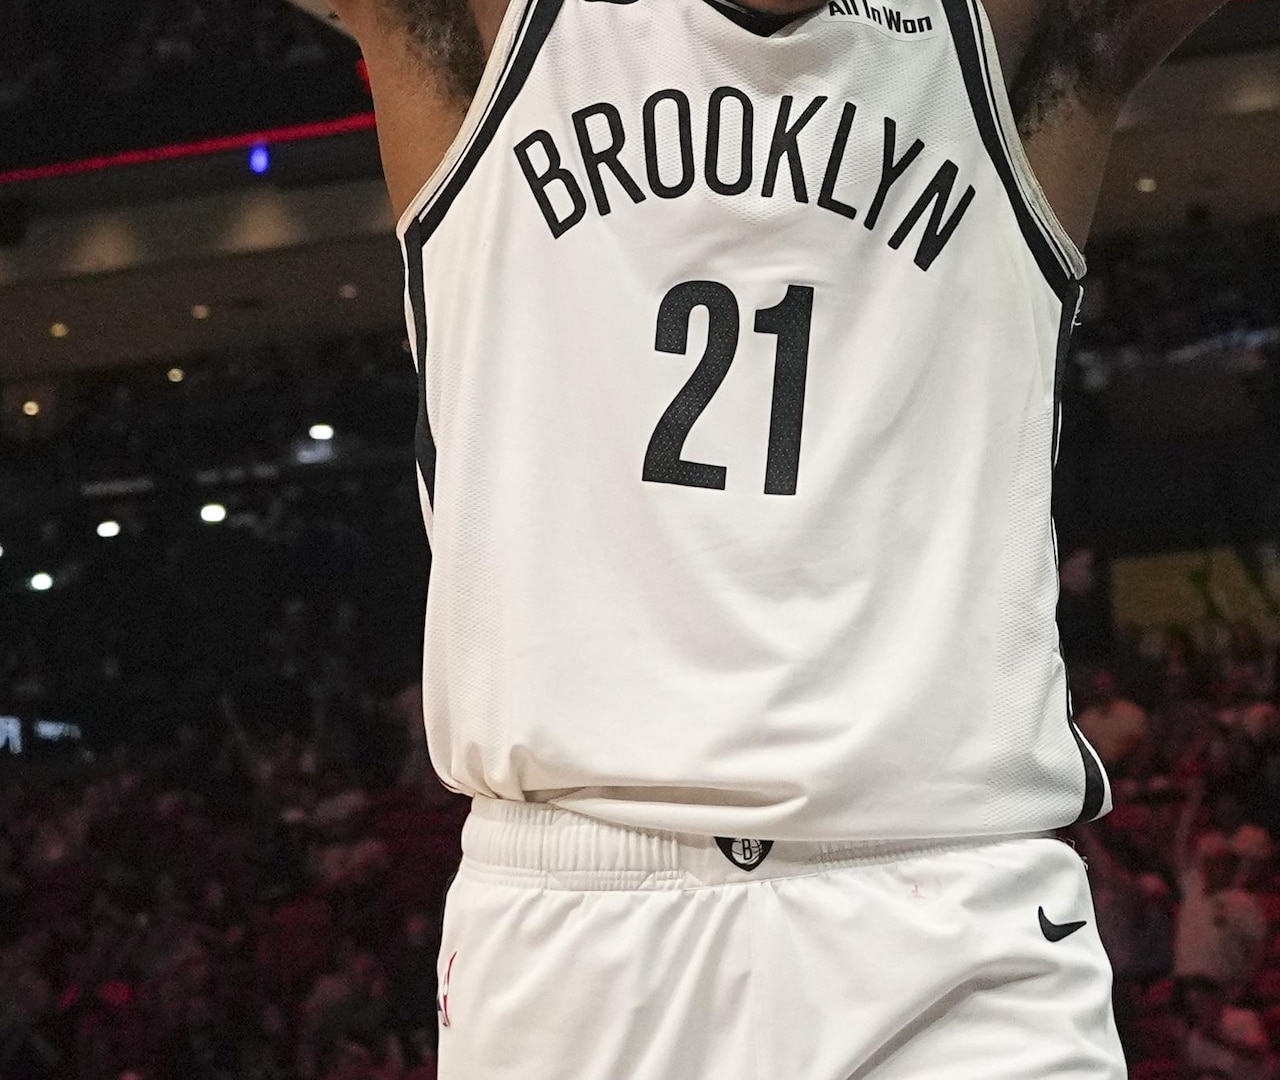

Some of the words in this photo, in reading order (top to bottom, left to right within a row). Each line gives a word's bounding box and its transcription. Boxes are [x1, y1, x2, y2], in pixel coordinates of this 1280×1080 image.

[883, 5, 933, 34] Won
[514, 85, 977, 272] BROOKLYN
[641, 280, 815, 496] 21
